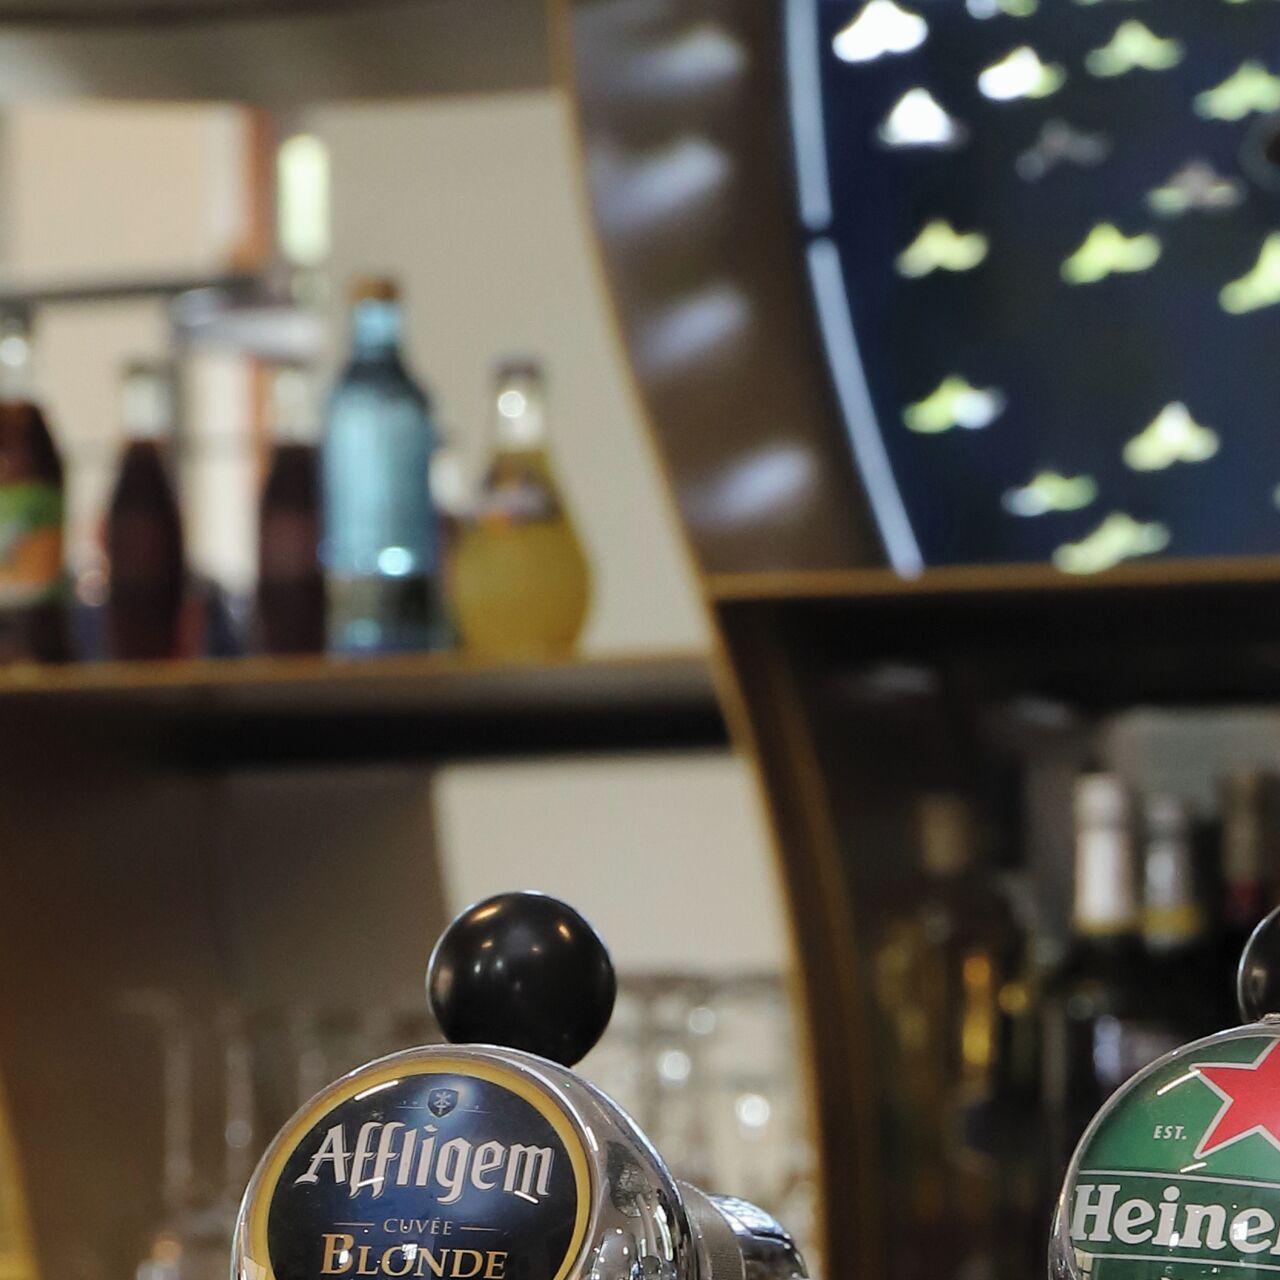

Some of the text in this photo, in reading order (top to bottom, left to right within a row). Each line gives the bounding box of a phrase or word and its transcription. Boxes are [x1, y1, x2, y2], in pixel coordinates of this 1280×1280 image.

[1152, 1124, 1188, 1141] EST.
[293, 1122, 555, 1205] Affligem
[383, 1216, 454, 1236] CUVÉE
[320, 1232, 508, 1280] BLONDE
